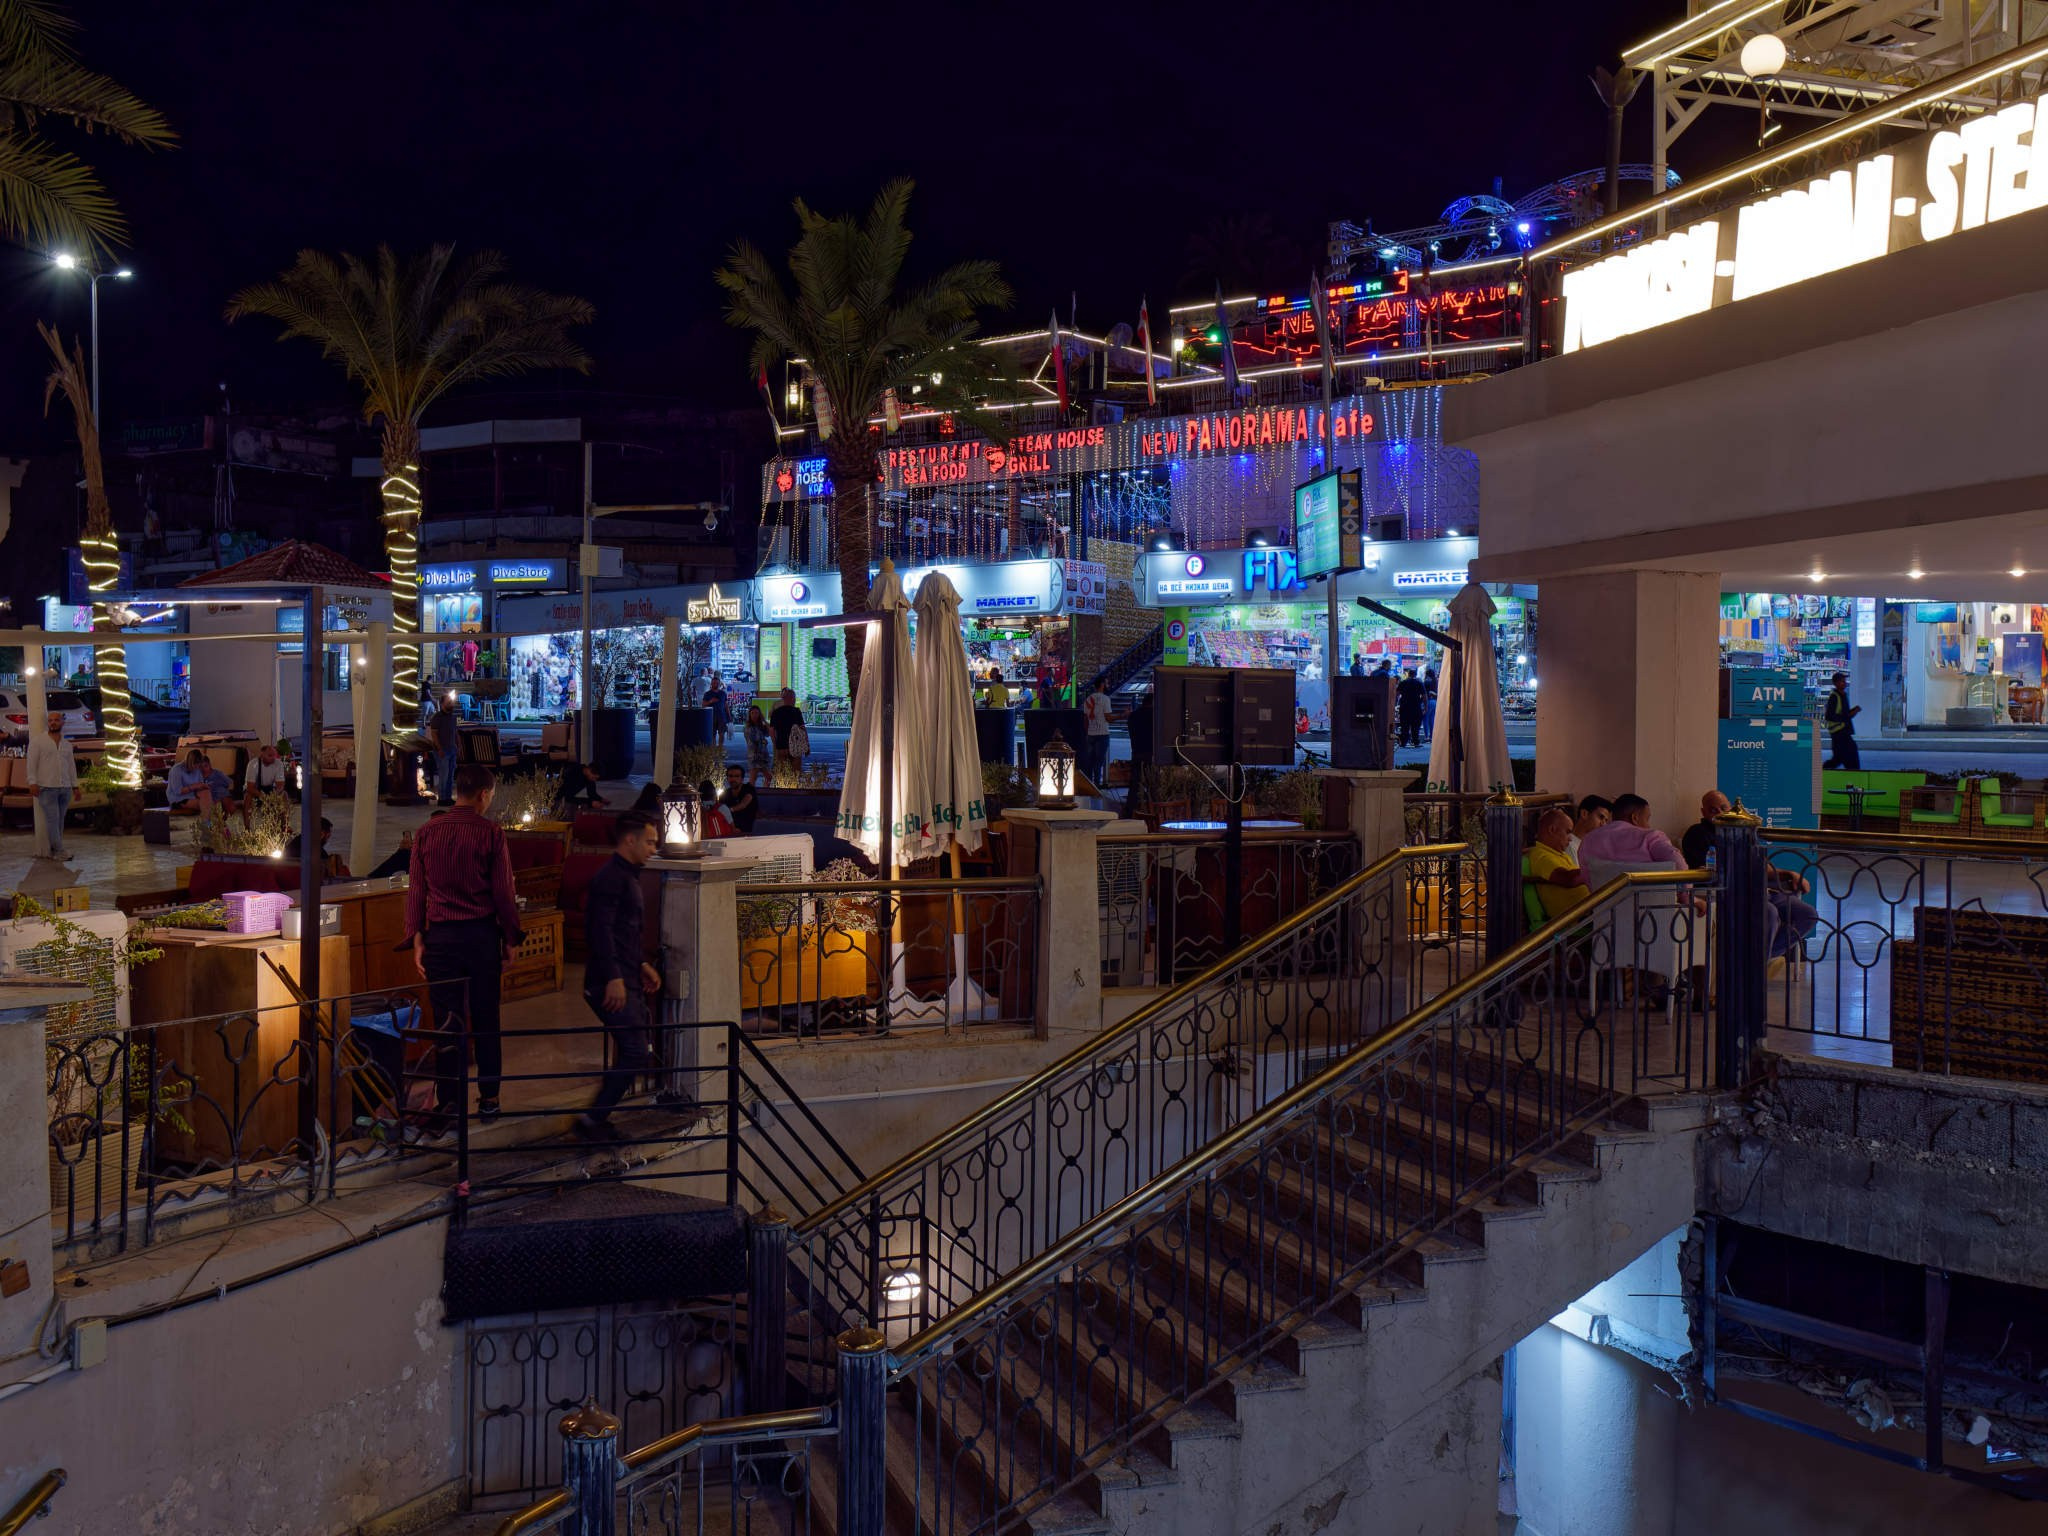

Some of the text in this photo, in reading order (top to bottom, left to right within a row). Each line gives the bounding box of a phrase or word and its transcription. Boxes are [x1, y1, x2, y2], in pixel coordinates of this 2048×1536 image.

[1057, 427, 1105, 449] HOUSE
[1142, 432, 1178, 455] NEW
[1186, 408, 1308, 451] PANORAMA
[903, 453, 1051, 485] SEA FOOD GRILL
[425, 573, 447, 585] Dive
[518, 566, 548, 577] Store
[975, 596, 1036, 608] MARKET
[1352, 618, 1386, 627] ENTRANCE
[970, 631, 989, 640] EXIT
[1752, 686, 1785, 701] ATM
[1727, 739, 1766, 750] Euronet
